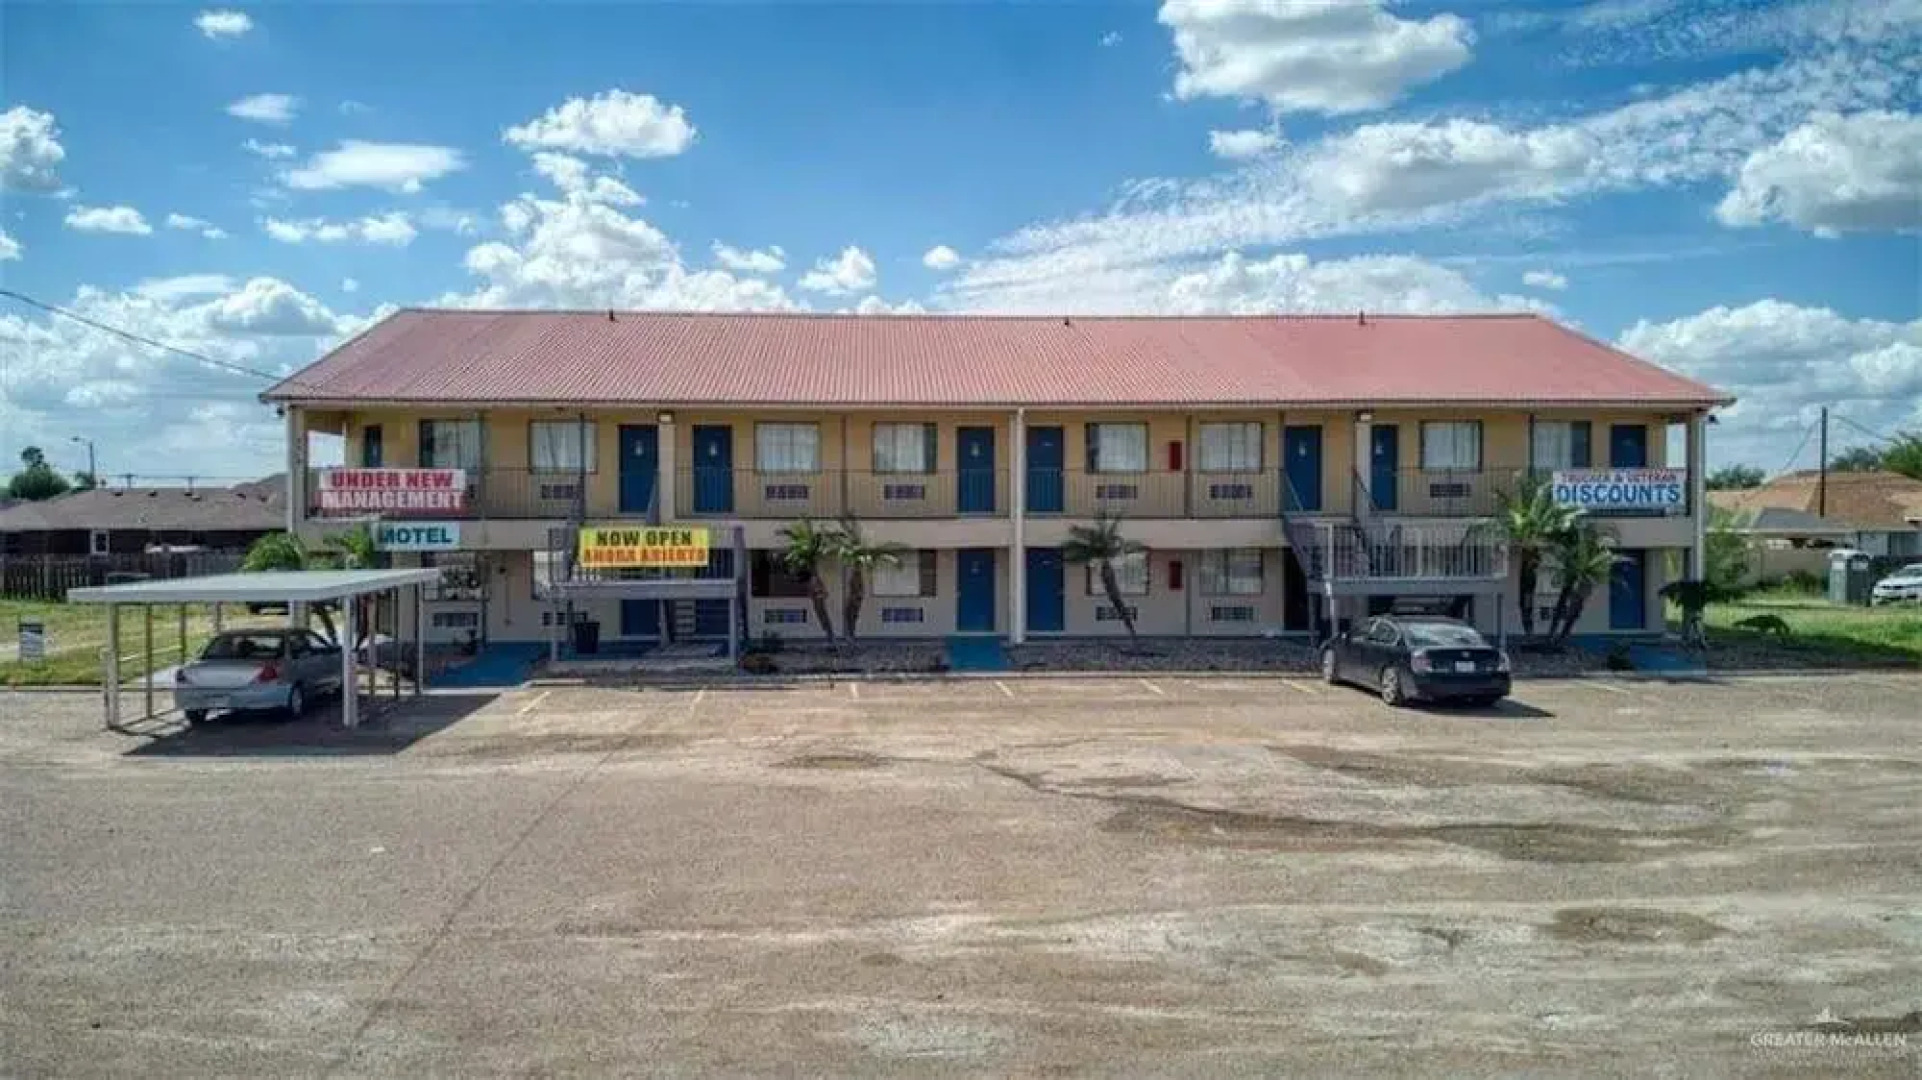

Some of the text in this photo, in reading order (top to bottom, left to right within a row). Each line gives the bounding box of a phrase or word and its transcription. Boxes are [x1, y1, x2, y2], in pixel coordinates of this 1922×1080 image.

[331, 472, 453, 487] UNDER NEW
[322, 491, 461, 508] MANAGEMENT
[1556, 484, 1681, 502] DISCOUNTS
[379, 527, 454, 544] MOTEL
[597, 530, 692, 546] NOW OPEN
